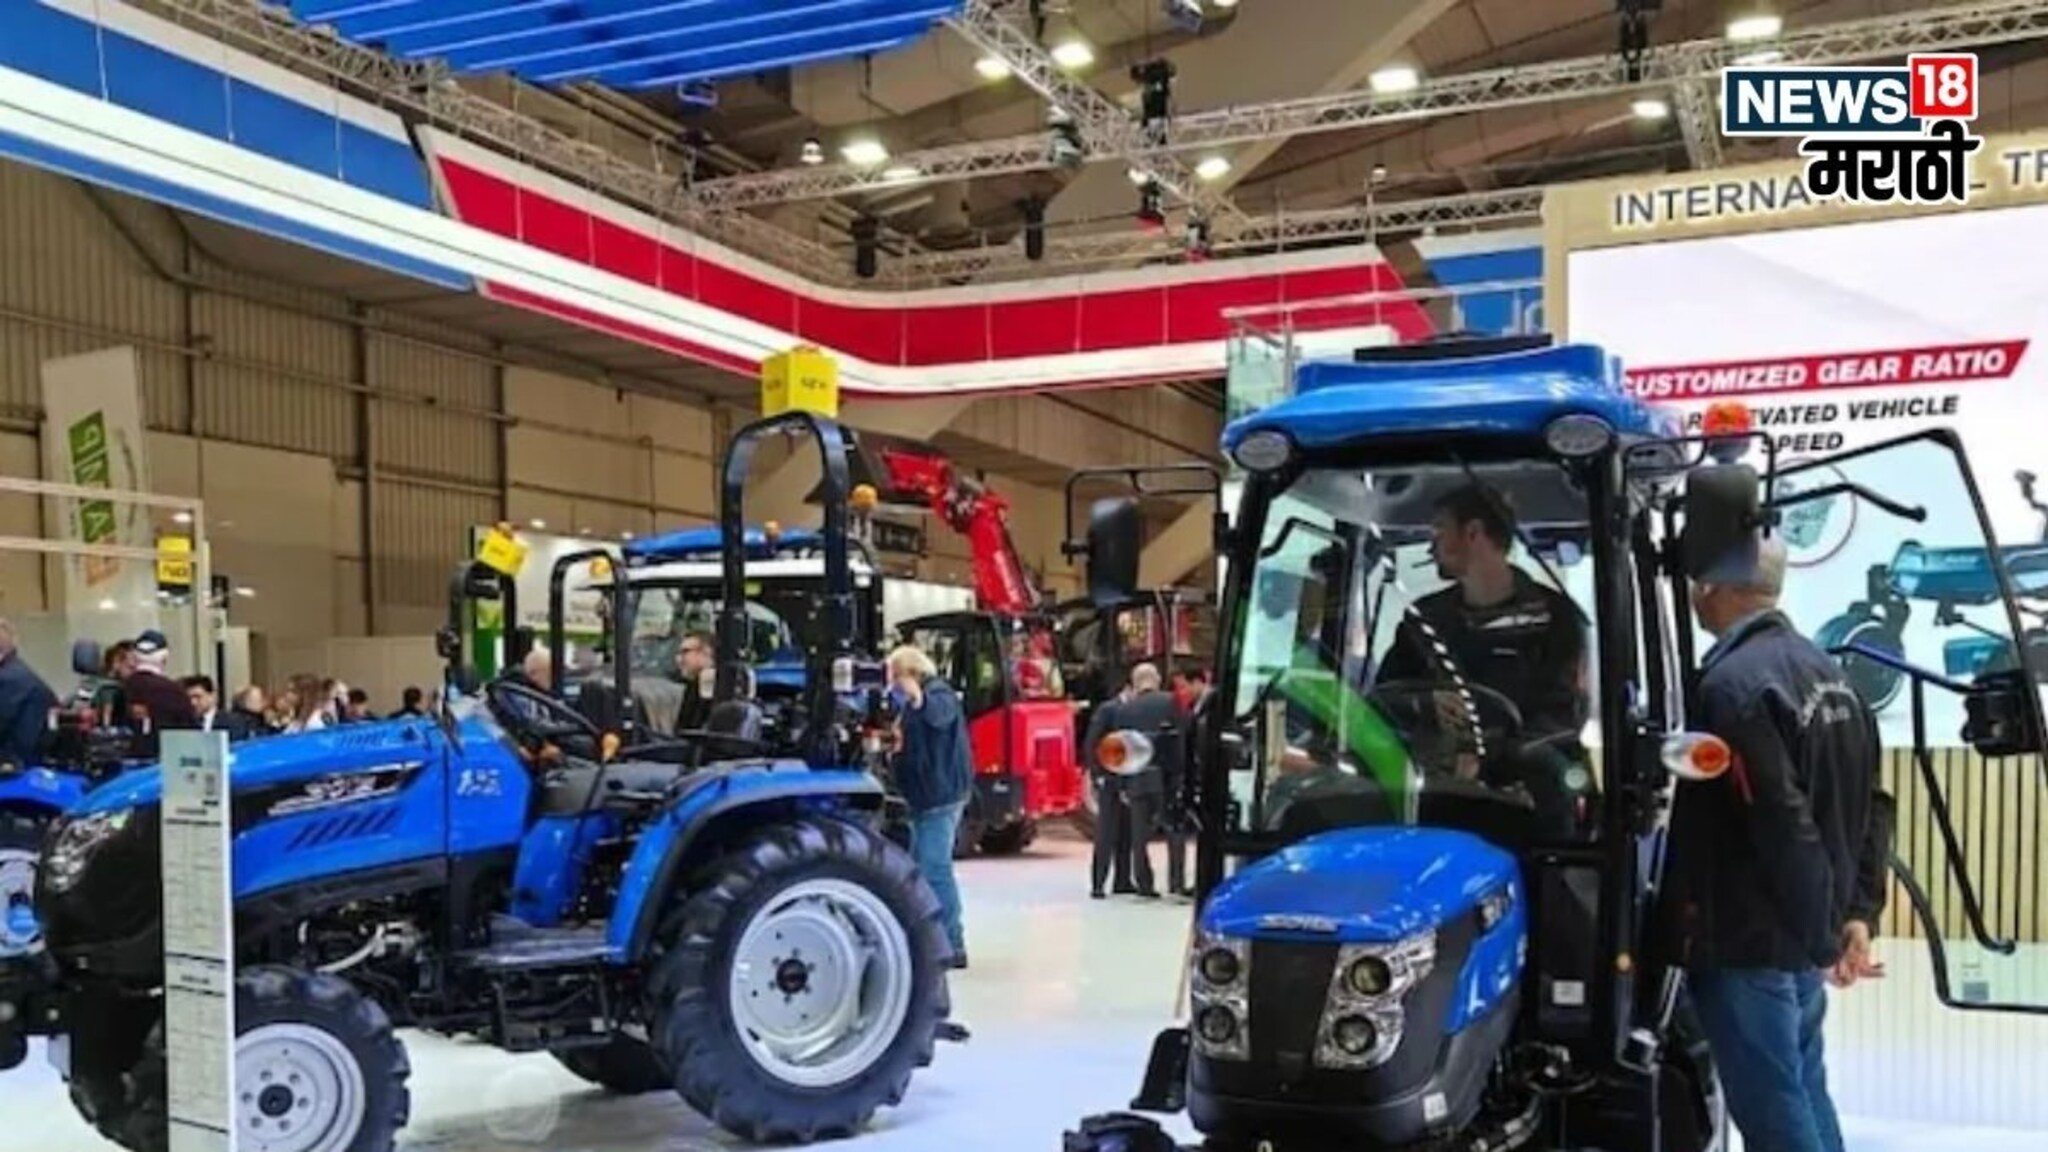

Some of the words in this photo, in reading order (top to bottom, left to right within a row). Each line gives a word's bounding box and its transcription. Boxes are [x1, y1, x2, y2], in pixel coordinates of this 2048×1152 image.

[1817, 357, 1902, 386] GEAR
[1910, 350, 2007, 379] RATIO
[1849, 395, 1960, 421] VEHICLE
